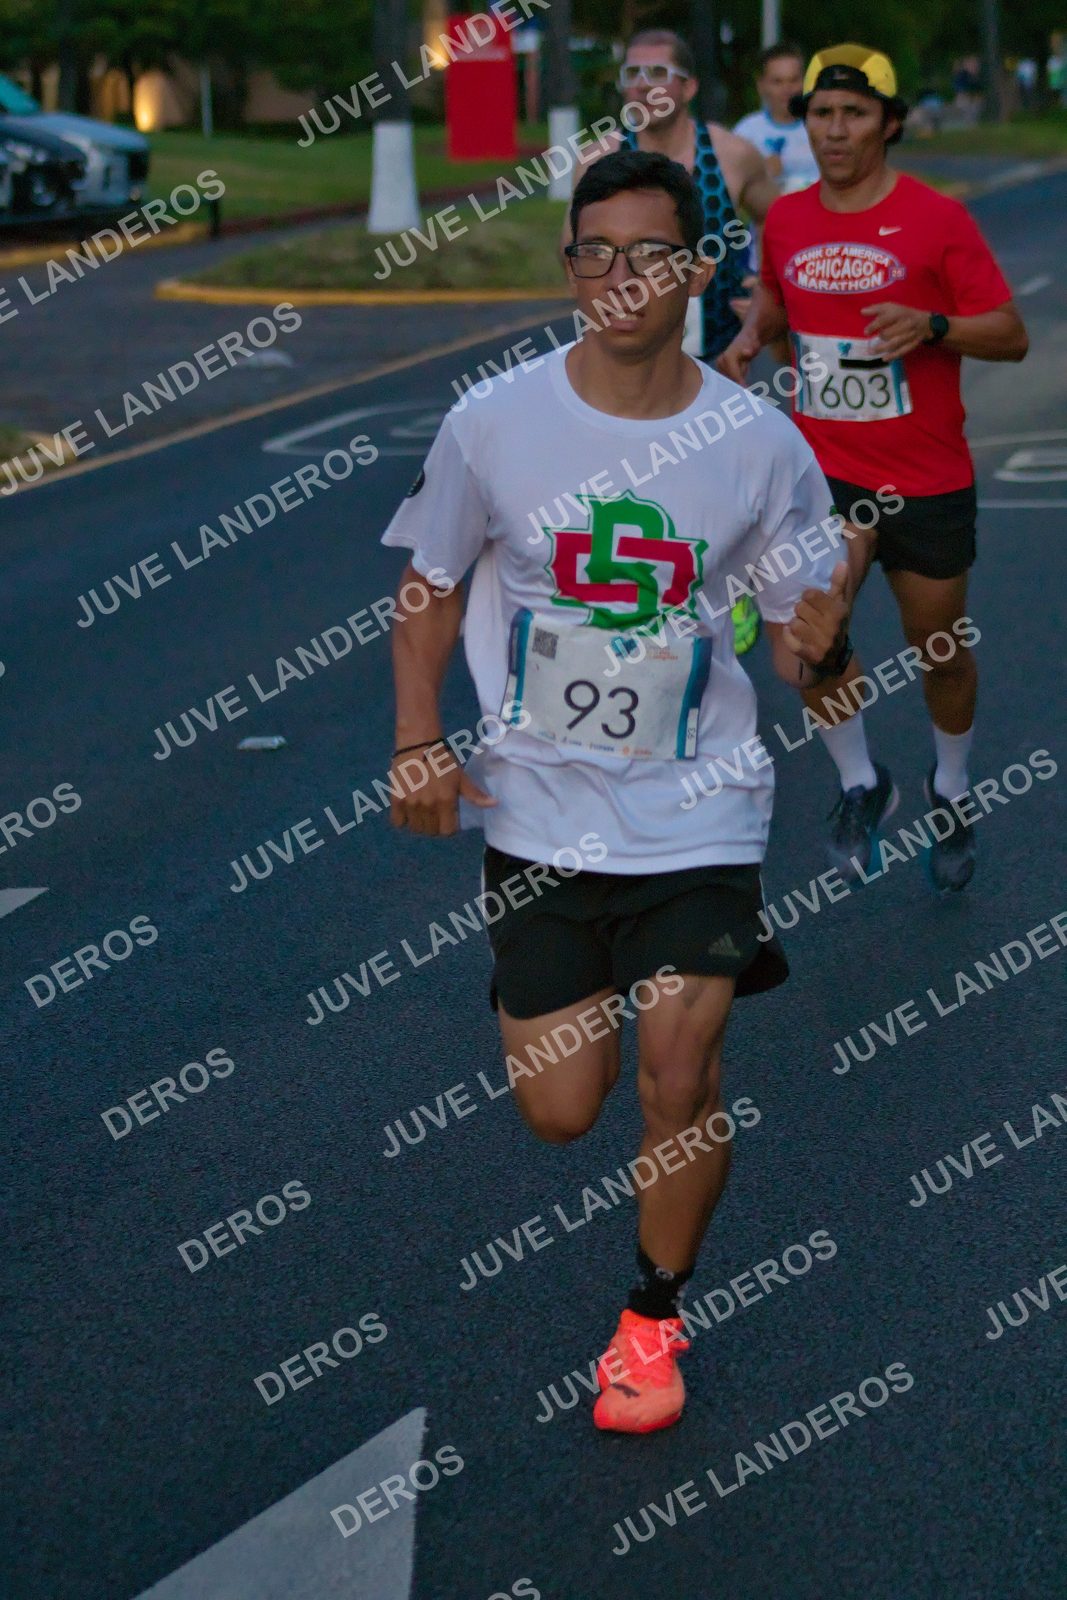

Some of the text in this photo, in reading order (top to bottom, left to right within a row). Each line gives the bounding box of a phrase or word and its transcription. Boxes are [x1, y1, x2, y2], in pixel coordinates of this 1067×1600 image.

[825, 246, 841, 257] OF
[841, 246, 890, 267] AMERICA
[805, 257, 874, 279] CHICAGO
[797, 271, 884, 291] MARATHON
[563, 679, 639, 739] 93
